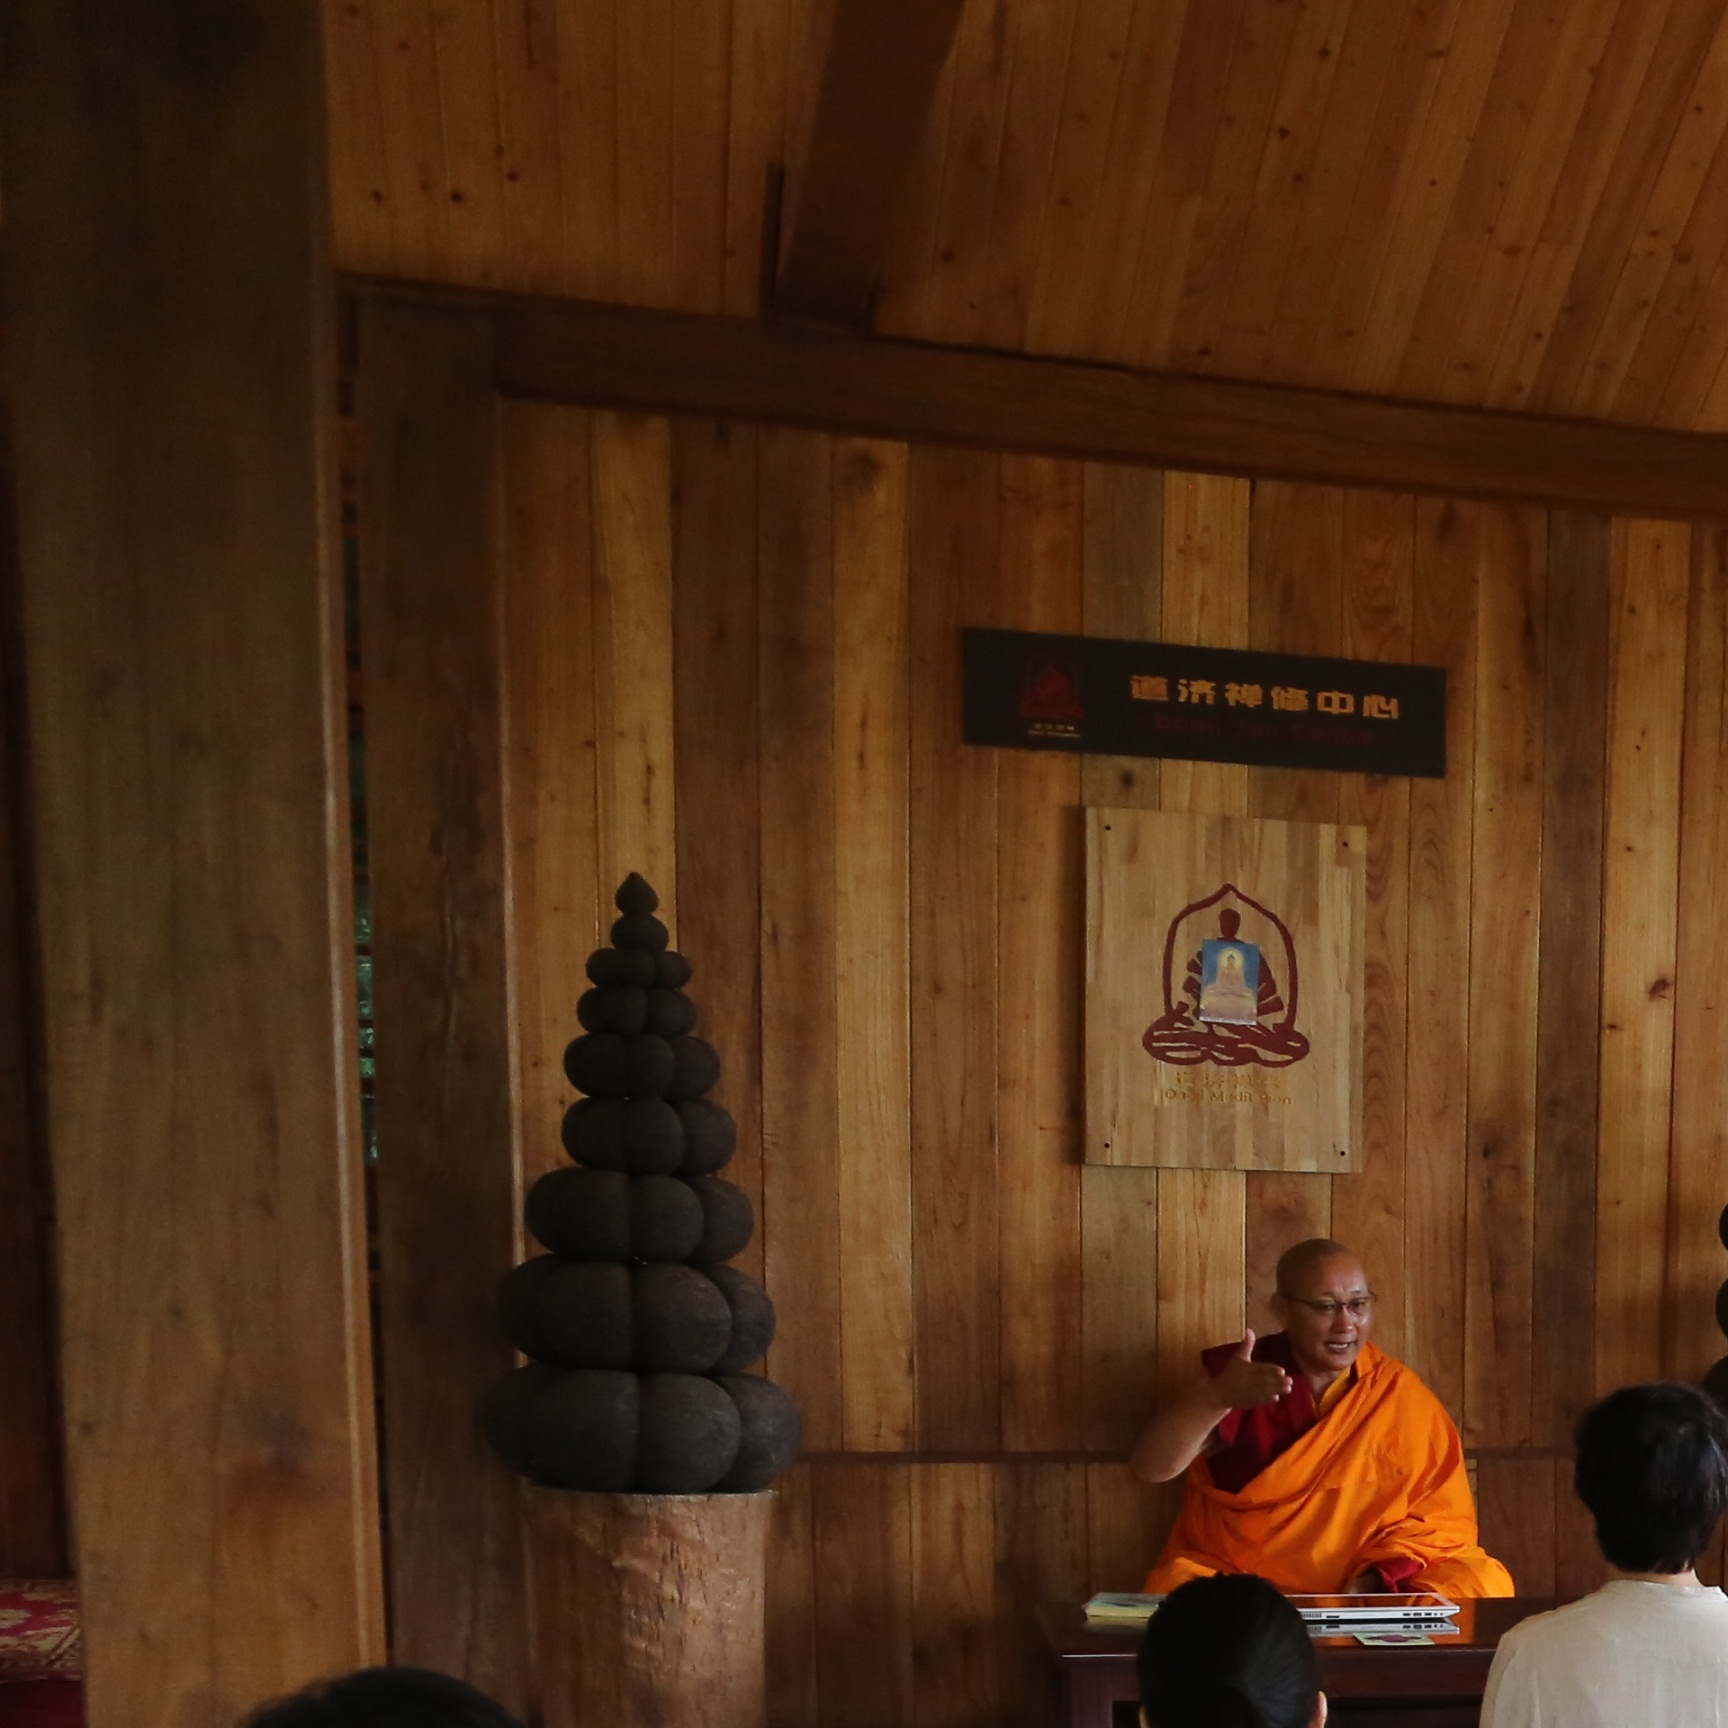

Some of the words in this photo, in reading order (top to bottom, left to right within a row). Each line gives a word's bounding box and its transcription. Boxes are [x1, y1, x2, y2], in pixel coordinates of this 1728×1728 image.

[1130, 673, 1401, 720] 道济禅修中心
